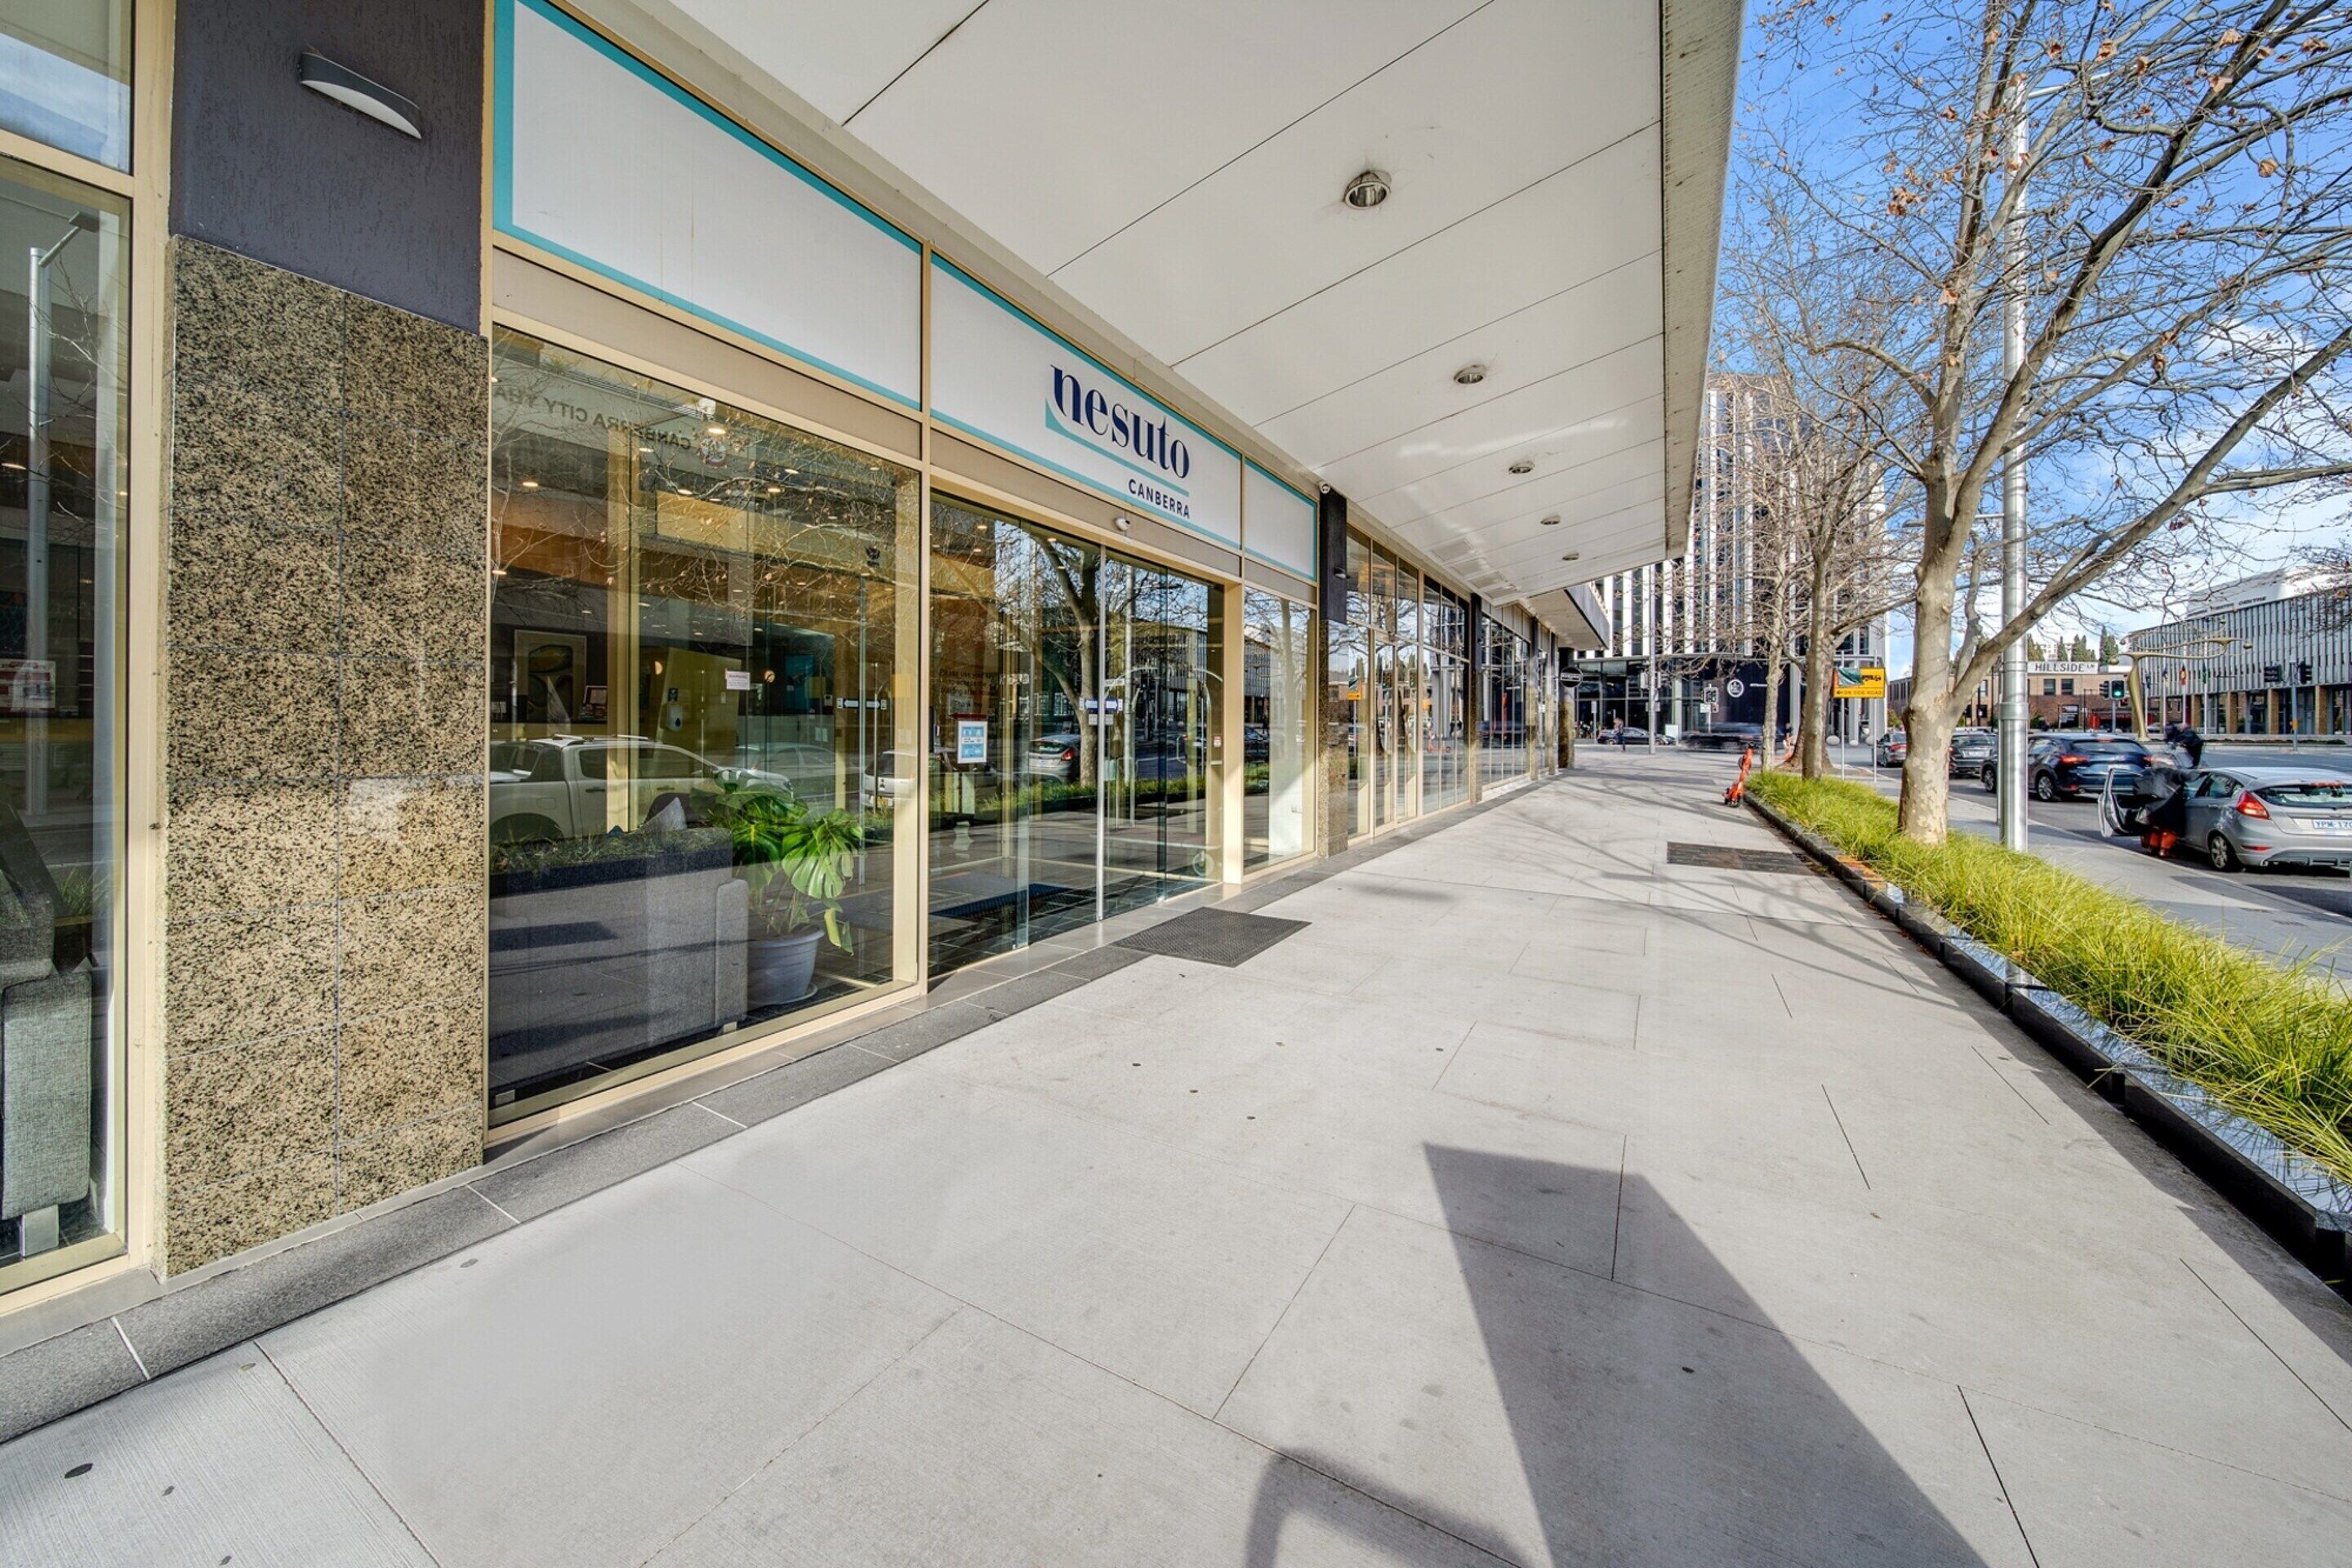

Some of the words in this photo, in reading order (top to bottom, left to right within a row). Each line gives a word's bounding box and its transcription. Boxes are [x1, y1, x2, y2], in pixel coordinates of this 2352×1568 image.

[1050, 364, 1190, 479] nesuto
[1128, 478, 1191, 519] CANBERRA
[2034, 662, 2084, 672] HILLSIDE
